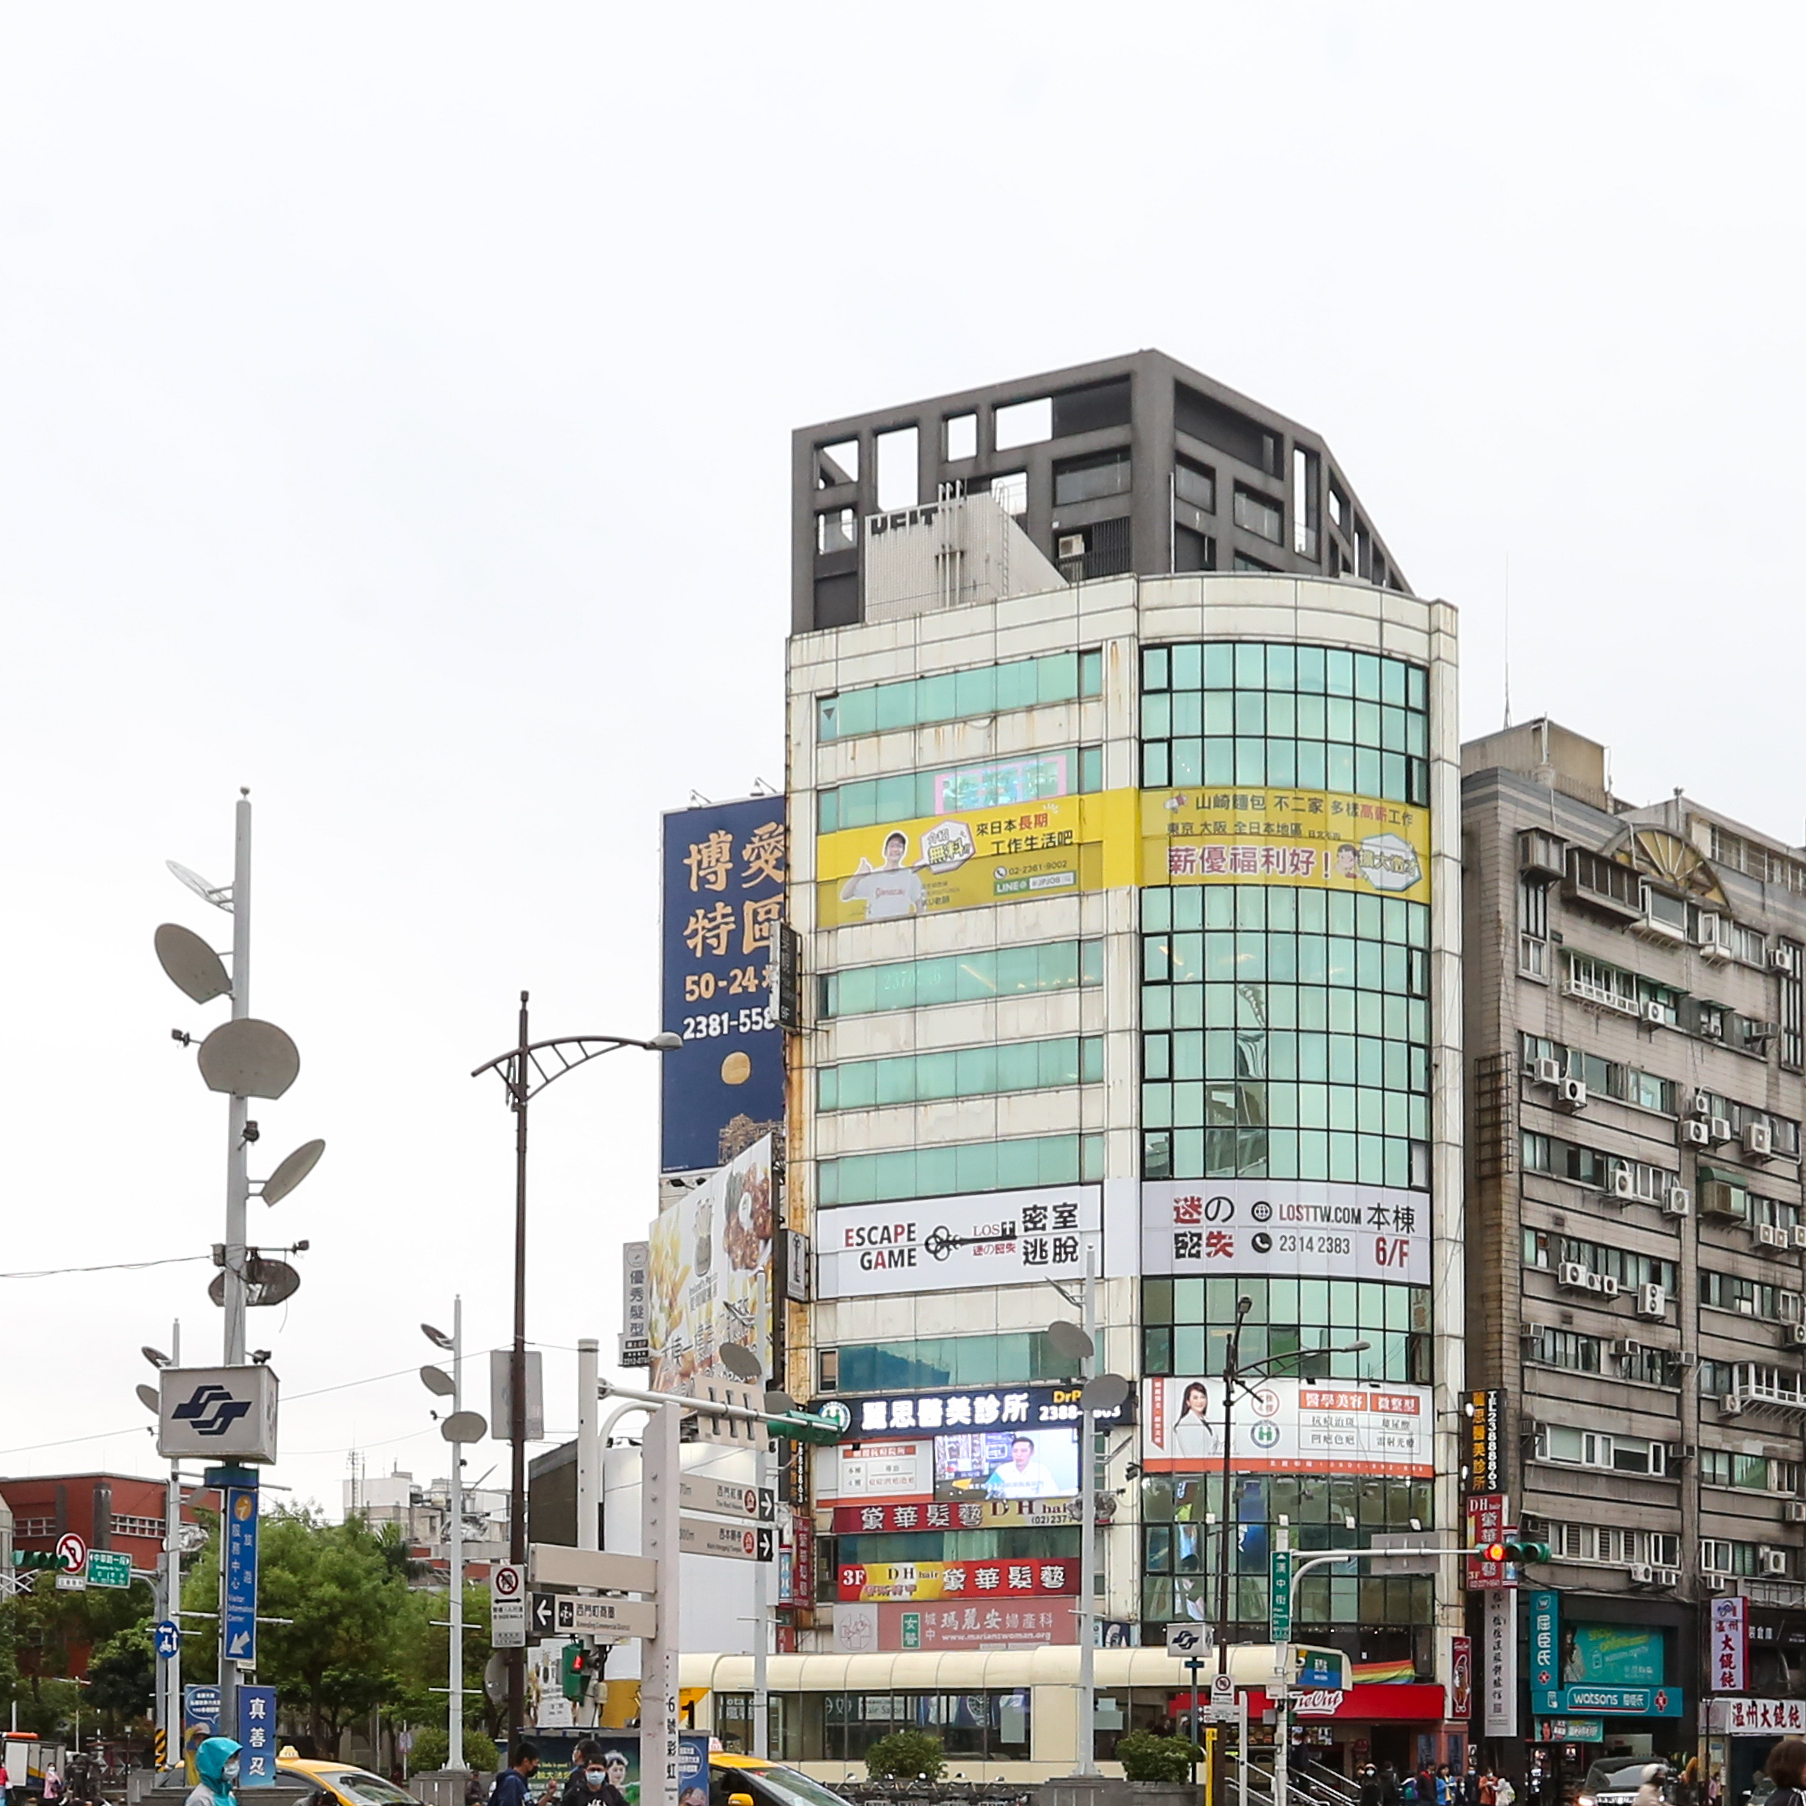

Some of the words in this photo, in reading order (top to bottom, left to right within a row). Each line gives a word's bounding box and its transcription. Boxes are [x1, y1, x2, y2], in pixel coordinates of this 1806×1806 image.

[975, 812, 1049, 837] 來日本長期
[1195, 794, 1267, 812] 山崎麵包
[1272, 796, 1324, 815] 不二家
[1330, 799, 1414, 827] 多樣高薪工作
[990, 829, 1074, 857] 工作生活吧
[1166, 821, 1194, 836] 東京
[1199, 820, 1227, 835] 大阪
[1234, 821, 1303, 837] 全日本地區
[682, 820, 785, 893] 博愛
[682, 894, 784, 958] 特區
[682, 1006, 776, 1041] 2381-558
[1021, 1202, 1079, 1233] 密室
[1173, 1195, 1235, 1225] 迷の
[1278, 1203, 1362, 1226] LOSTTW.COM
[1366, 1202, 1416, 1235] 本棟
[844, 1222, 917, 1249] ESCAPE
[1279, 1235, 1314, 1253] 2314
[1317, 1236, 1350, 1255] 2383
[859, 1248, 917, 1271] GAME
[1021, 1236, 1080, 1267] 逃脫
[1375, 1236, 1410, 1268] 6/F
[629, 1269, 645, 1338] 優秀髮型
[1052, 1389, 1082, 1404] DrP
[1305, 1392, 1363, 1409] 醫學美容
[1377, 1396, 1416, 1413] 微整型
[860, 1392, 1031, 1432] 麗思醫美診所
[1472, 1391, 1486, 1491] 麗思醫美診所
[716, 1484, 744, 1500] 西門紅樓
[1469, 1499, 1489, 1513] DH
[859, 1503, 984, 1531] 黛華髮藝
[230, 1522, 241, 1590] 服務中心
[842, 1569, 866, 1587] 3F
[917, 1571, 940, 1580] hair
[942, 1565, 1067, 1592] 黛華髮藝
[1275, 1561, 1287, 1606] 漢中街
[575, 1603, 616, 1620] 西門町商圈
[903, 1616, 917, 1647] 女醫
[1536, 1614, 1552, 1666] 屈臣氏
[1573, 1692, 1619, 1706] watsons
[681, 1700, 696, 1729] 1
[248, 1697, 268, 1778] 真善忍
